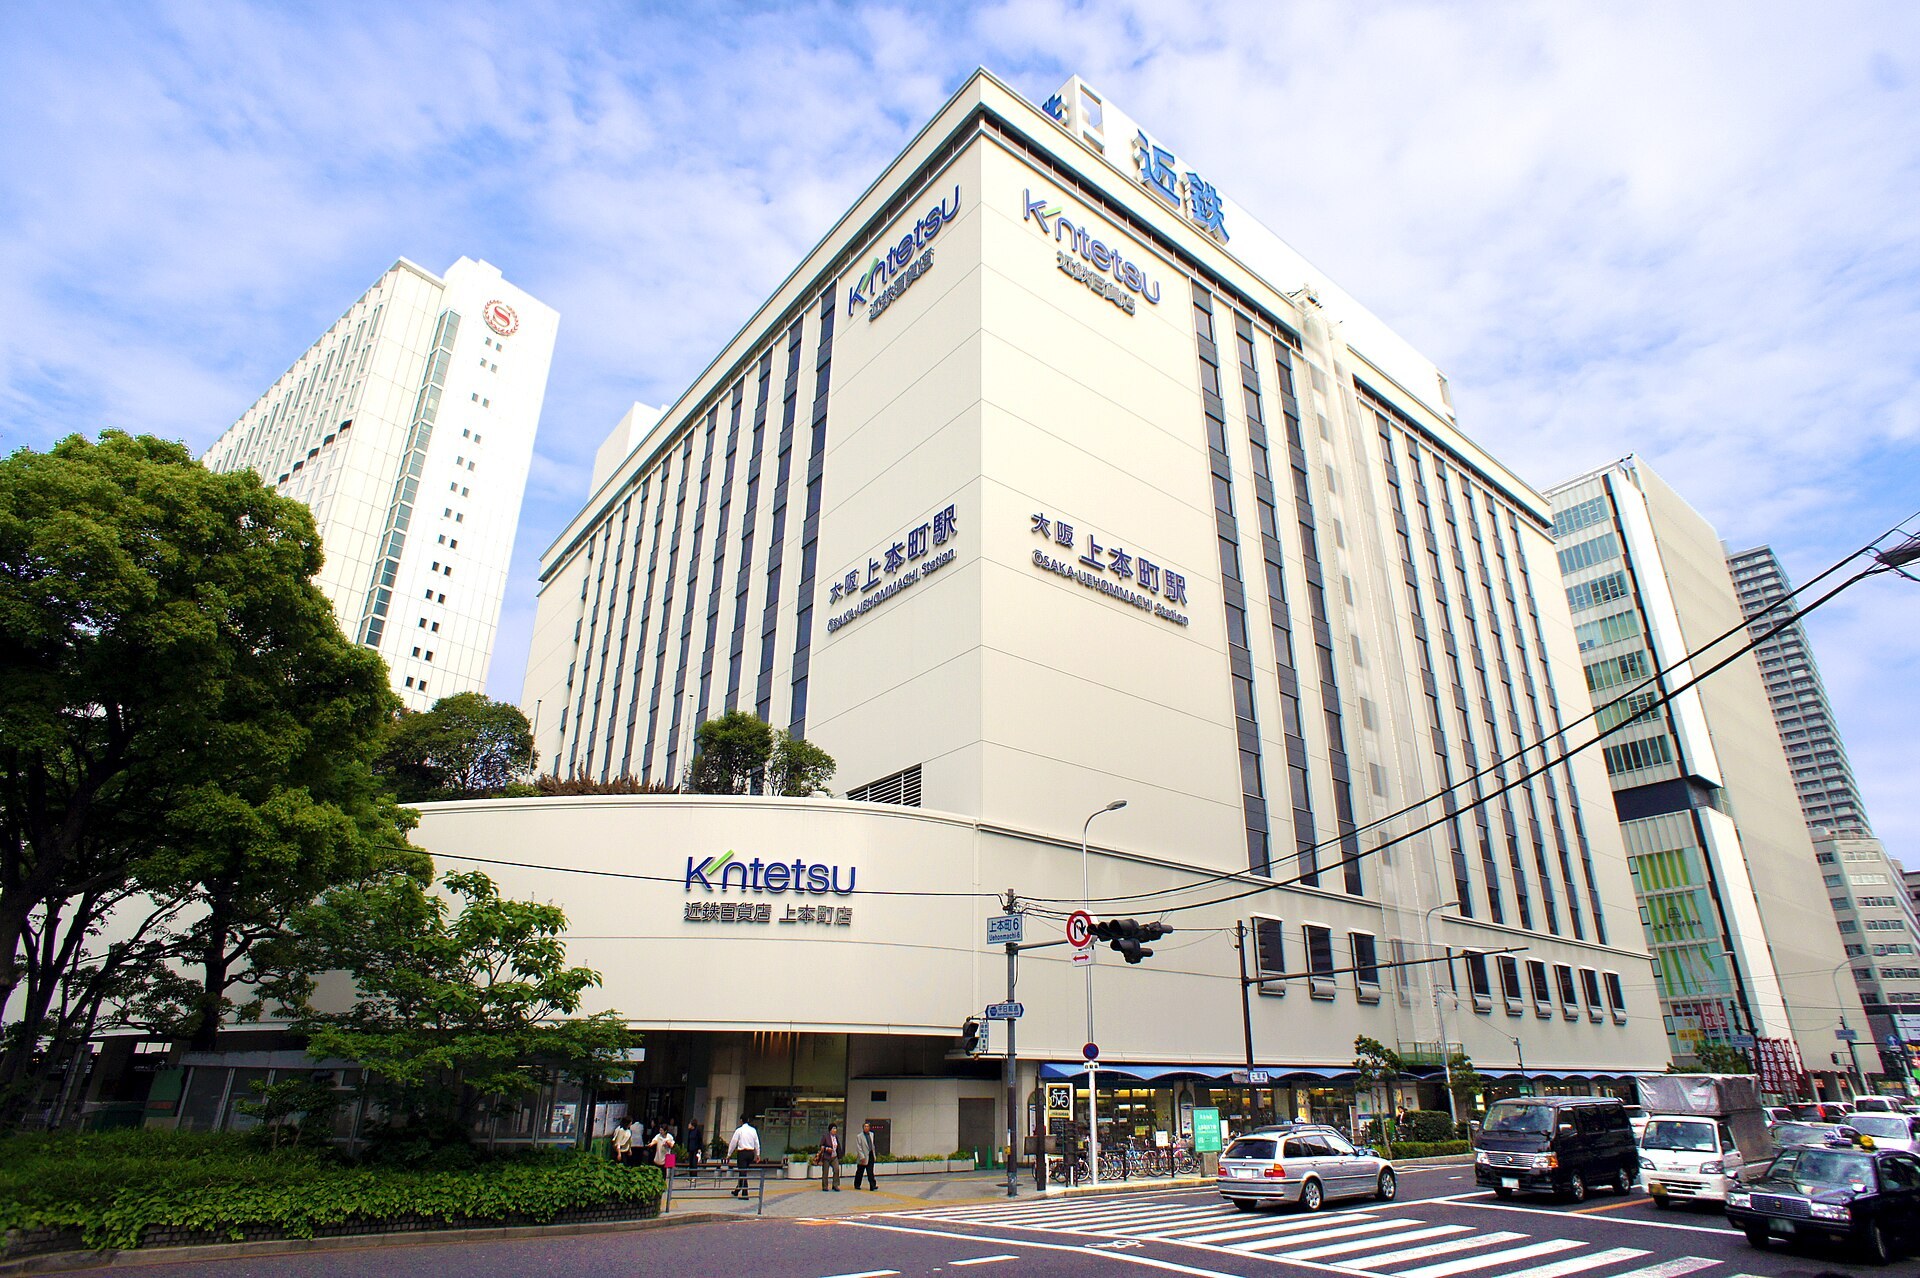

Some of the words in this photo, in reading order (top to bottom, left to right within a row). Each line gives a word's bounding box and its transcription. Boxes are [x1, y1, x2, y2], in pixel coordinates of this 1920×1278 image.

[1134, 128, 1230, 246] 近鉄
[921, 548, 956, 578] Station
[1154, 602, 1189, 627] Station
[684, 902, 772, 923] 近鉄百貨店
[779, 903, 853, 926] 上本町店
